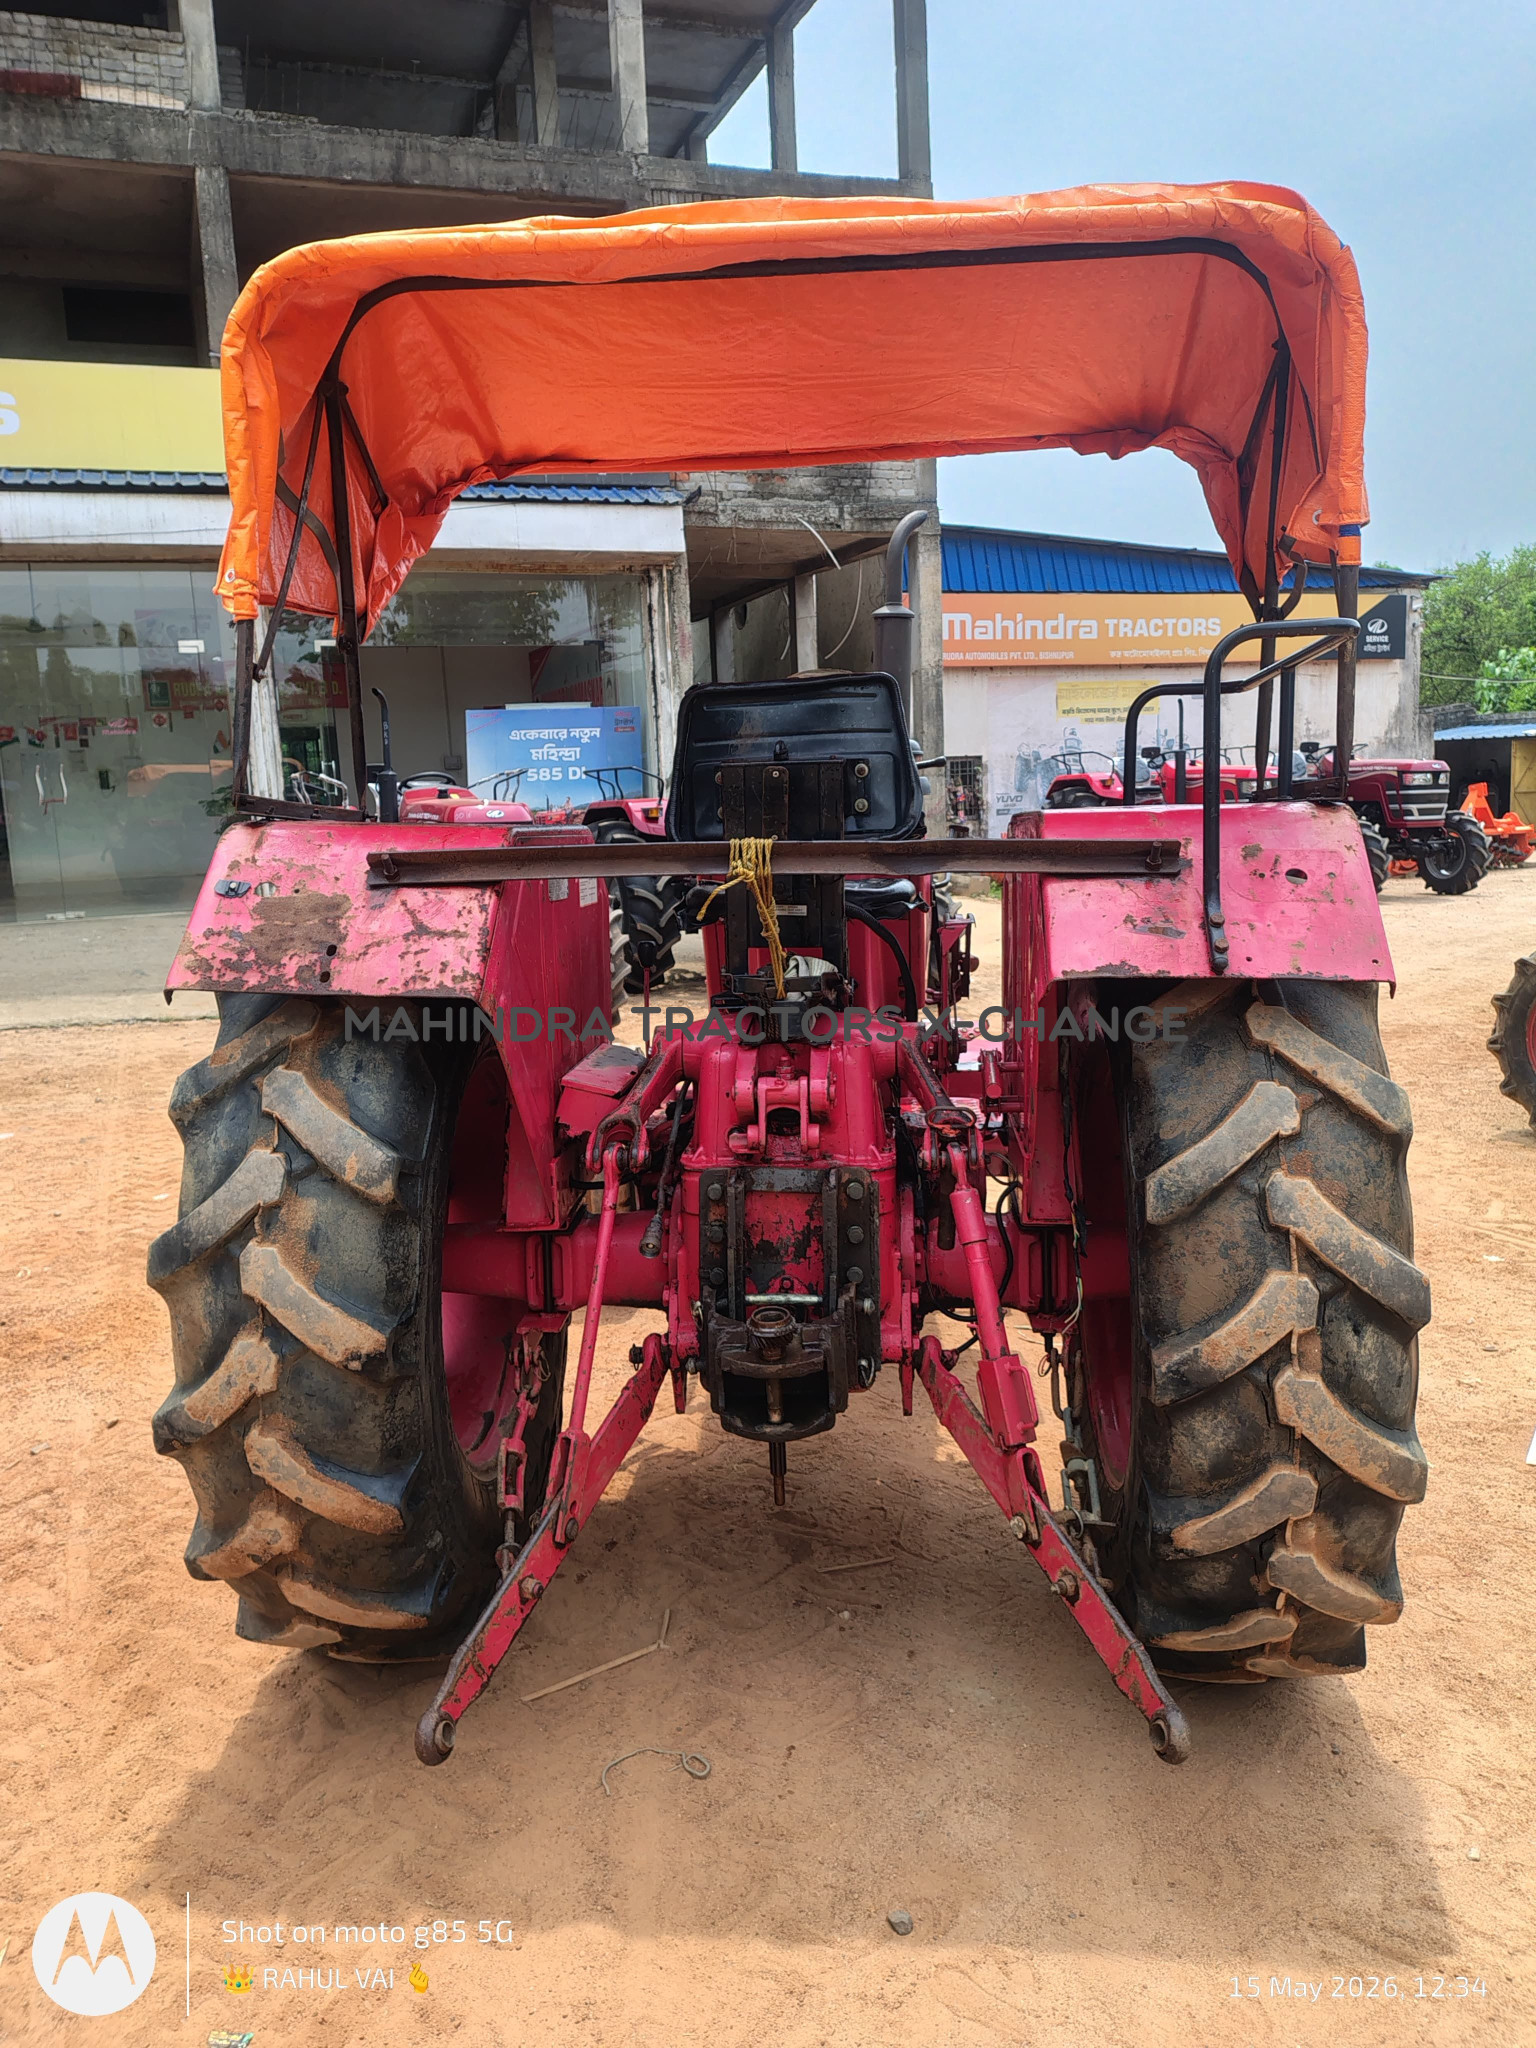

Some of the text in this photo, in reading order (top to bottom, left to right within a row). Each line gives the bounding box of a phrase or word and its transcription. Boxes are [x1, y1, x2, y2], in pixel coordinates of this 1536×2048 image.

[942, 613, 1221, 640] Mahindra TRACTORS
[1365, 635, 1389, 643] SERVICE
[965, 652, 1009, 660] AUTOMOBILES
[509, 727, 601, 743] একেবারে নতুন
[529, 743, 581, 762] মহিন্দ্রা
[526, 767, 587, 782] 585 DI
[996, 795, 1023, 803] YUVO
